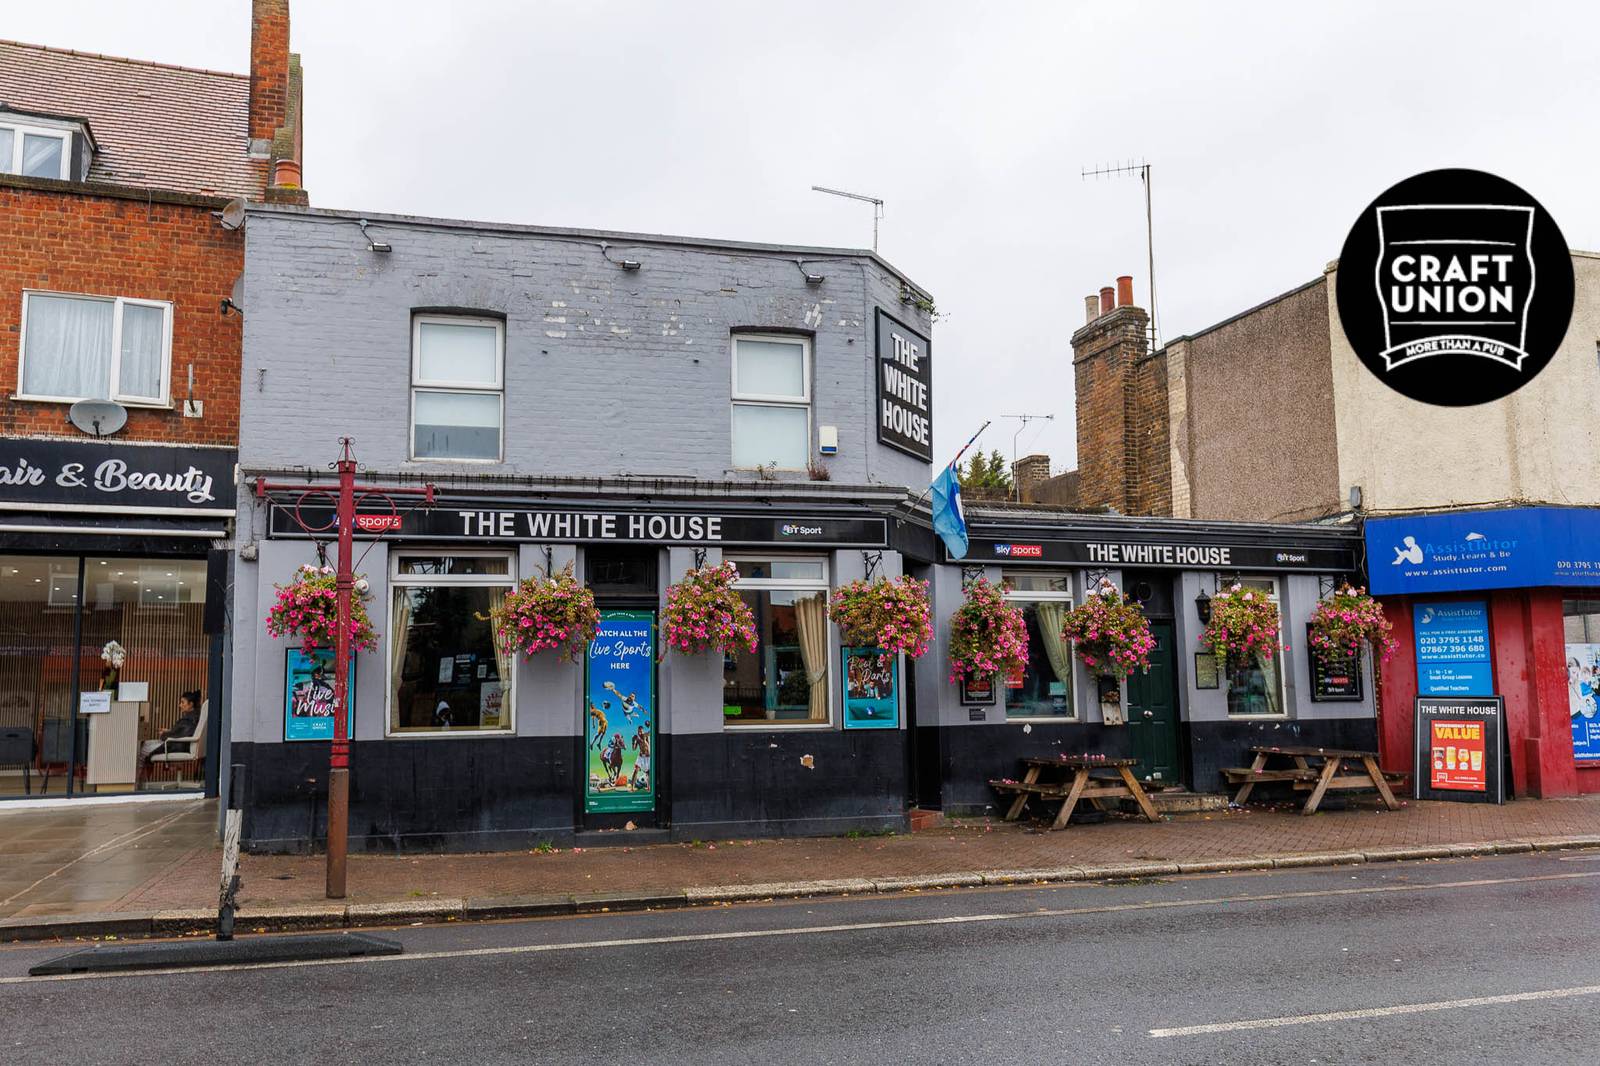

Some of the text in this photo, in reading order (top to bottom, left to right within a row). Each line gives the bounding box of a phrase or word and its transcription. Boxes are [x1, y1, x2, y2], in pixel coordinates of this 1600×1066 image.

[892, 332, 919, 373] THE
[884, 363, 927, 411] WHITE
[882, 398, 929, 446] HOUSE
[55, 463, 88, 488] &
[94, 459, 216, 504] Beauty
[359, 518, 399, 528] sports
[459, 512, 721, 540] THE WHITE HOUSE
[800, 526, 822, 535] Sport
[996, 545, 1041, 555] sky sports
[1086, 544, 1231, 565] THE WHITE HOUSE
[1404, 565, 1507, 577] www.assisttutor.com
[1437, 609, 1482, 617] AssistTutor
[1438, 636, 1460, 644] 3795
[1462, 635, 1484, 643] 1148
[590, 640, 652, 661] Live Sports
[1449, 645, 1466, 653] 396
[1468, 644, 1484, 652] 680
[610, 662, 630, 670] HERE
[307, 680, 332, 703] Live
[296, 699, 336, 717] Musi
[1421, 705, 1497, 715] THE WHITE HOUSE
[1435, 727, 1481, 740] VALUE
